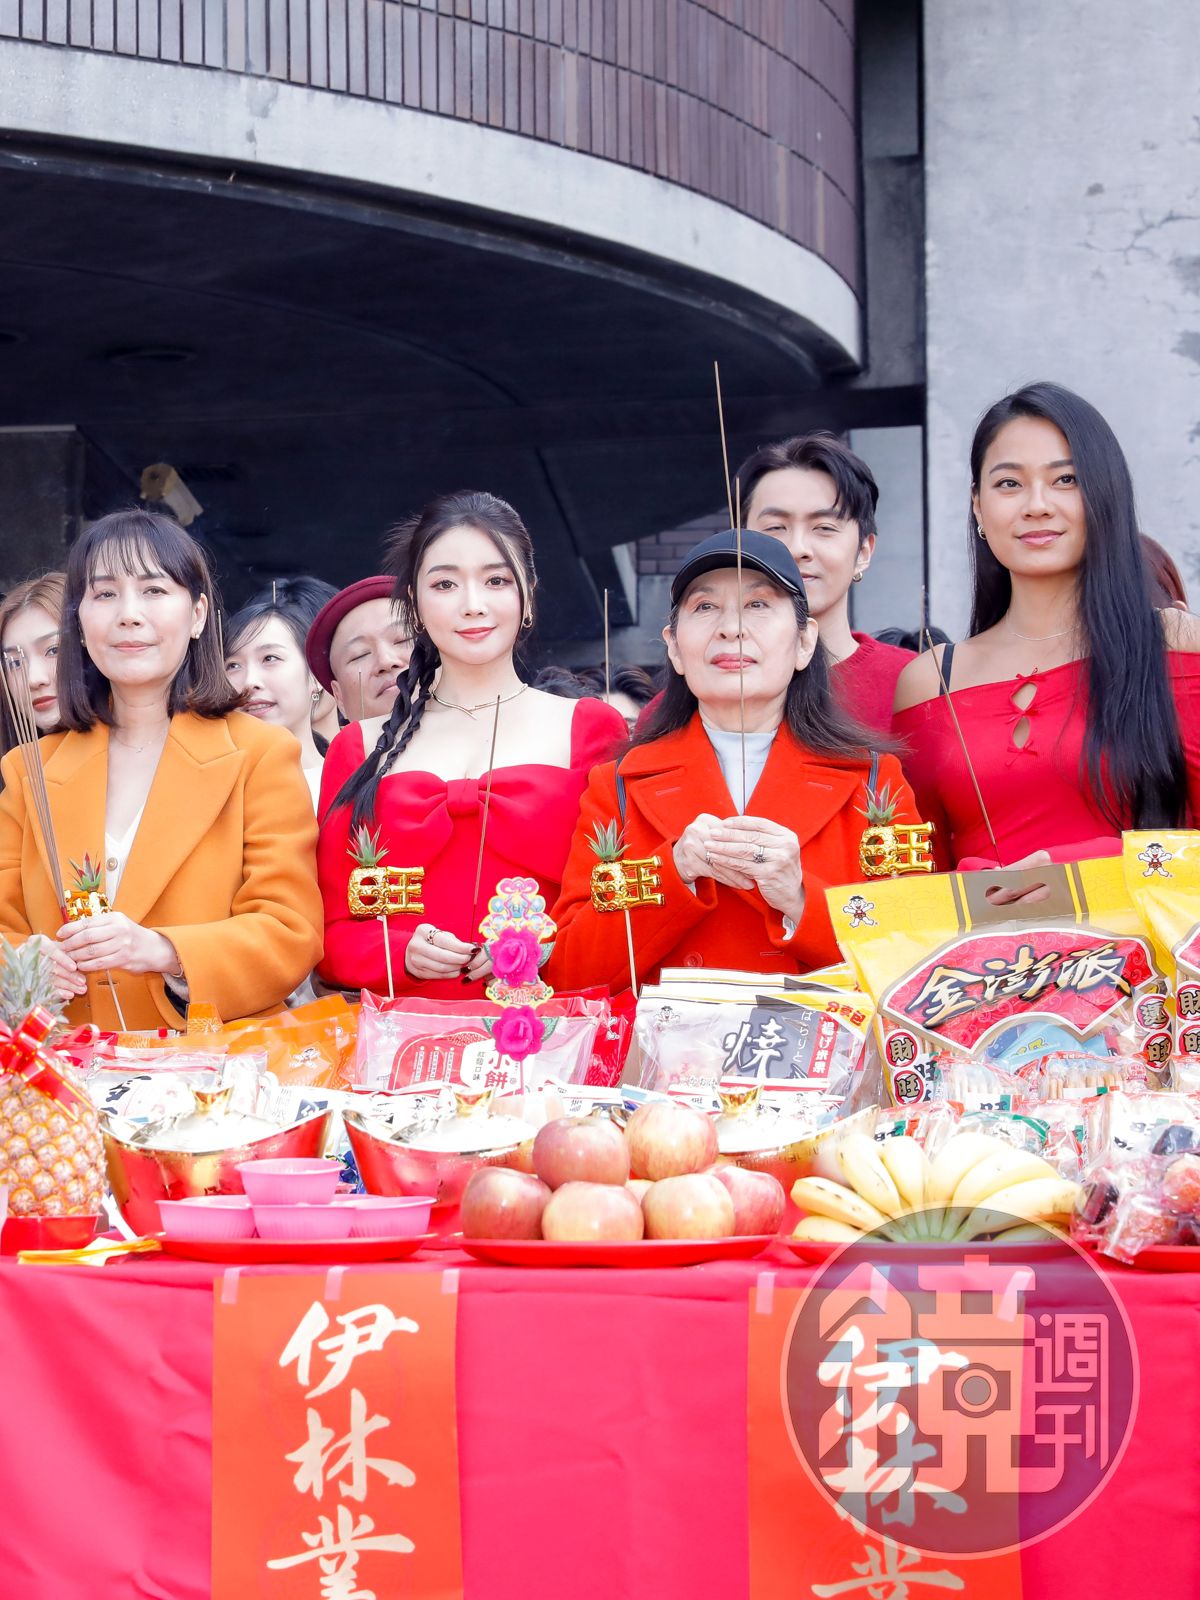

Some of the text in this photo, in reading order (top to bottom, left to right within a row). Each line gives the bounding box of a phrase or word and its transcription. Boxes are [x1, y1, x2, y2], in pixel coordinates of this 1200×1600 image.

[905, 942, 1135, 1029] 金澎派
[889, 1036, 915, 1063] 財
[895, 1074, 921, 1099] 旺
